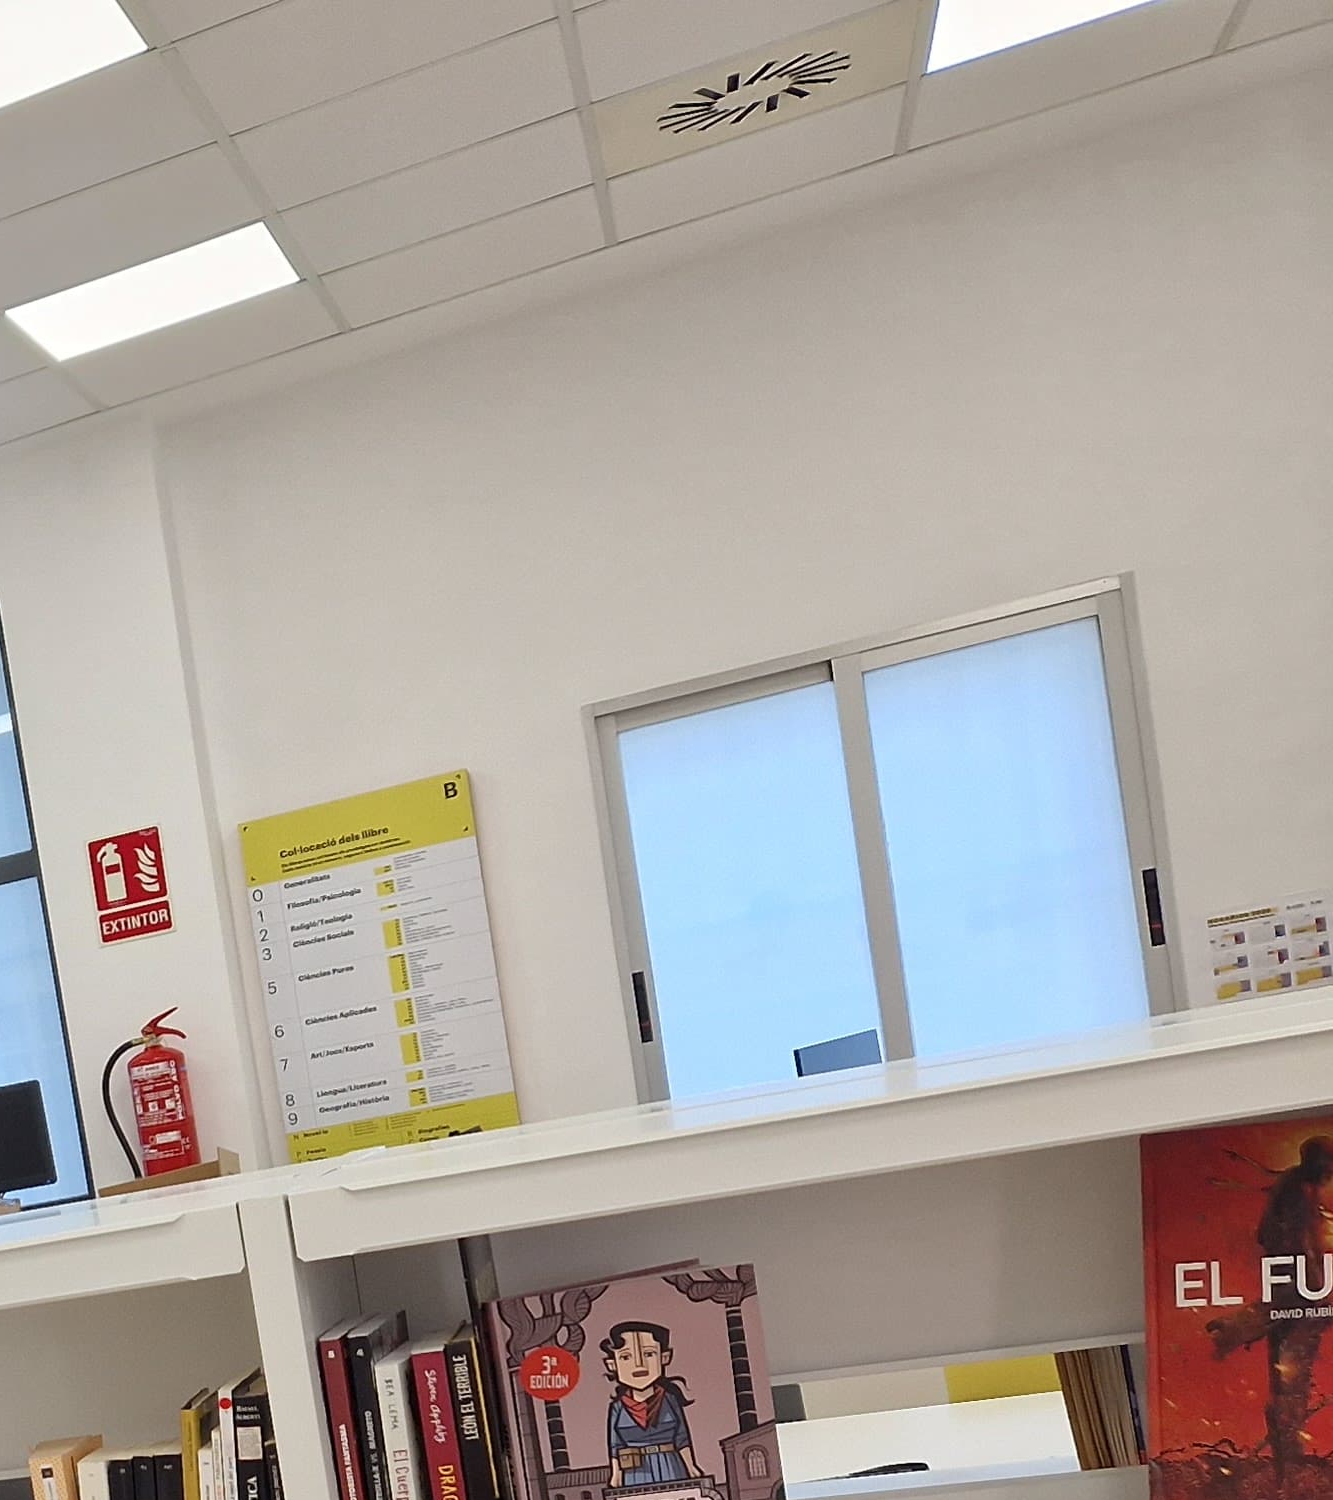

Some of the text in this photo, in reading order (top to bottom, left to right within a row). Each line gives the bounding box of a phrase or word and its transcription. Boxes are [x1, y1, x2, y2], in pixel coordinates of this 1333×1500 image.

[443, 781, 459, 799] B
[338, 832, 360, 846] dels
[252, 873, 331, 902] 0 Generalitats
[257, 887, 362, 923] 1 Filosofia/Psicologia
[102, 908, 170, 935] EXTINTOR
[259, 913, 353, 942] 2 Religió/Teologia
[262, 929, 355, 961] 3 Ciències Socials
[267, 964, 354, 995] 5 Ciències Pures
[274, 1005, 377, 1038] 6 Ciències Aplicades
[279, 1058, 289, 1071] 7
[285, 1078, 387, 1107] 8 Llengua/Literatura
[288, 1094, 390, 1126] 9 Geografia/Història
[1175, 1253, 1333, 1308] EL FU
[1270, 1305, 1333, 1320] DAVID RUBÍ
[541, 1355, 558, 1375] 3ª
[529, 1372, 569, 1389] EDICIÓN
[384, 1378, 399, 1431] BEA LEMA
[452, 1354, 480, 1440] LEÓN EL TERRIBLE
[339, 1423, 352, 1466] FANTASMA
[364, 1410, 377, 1450] MAGNETO
[393, 1449, 409, 1462] El
